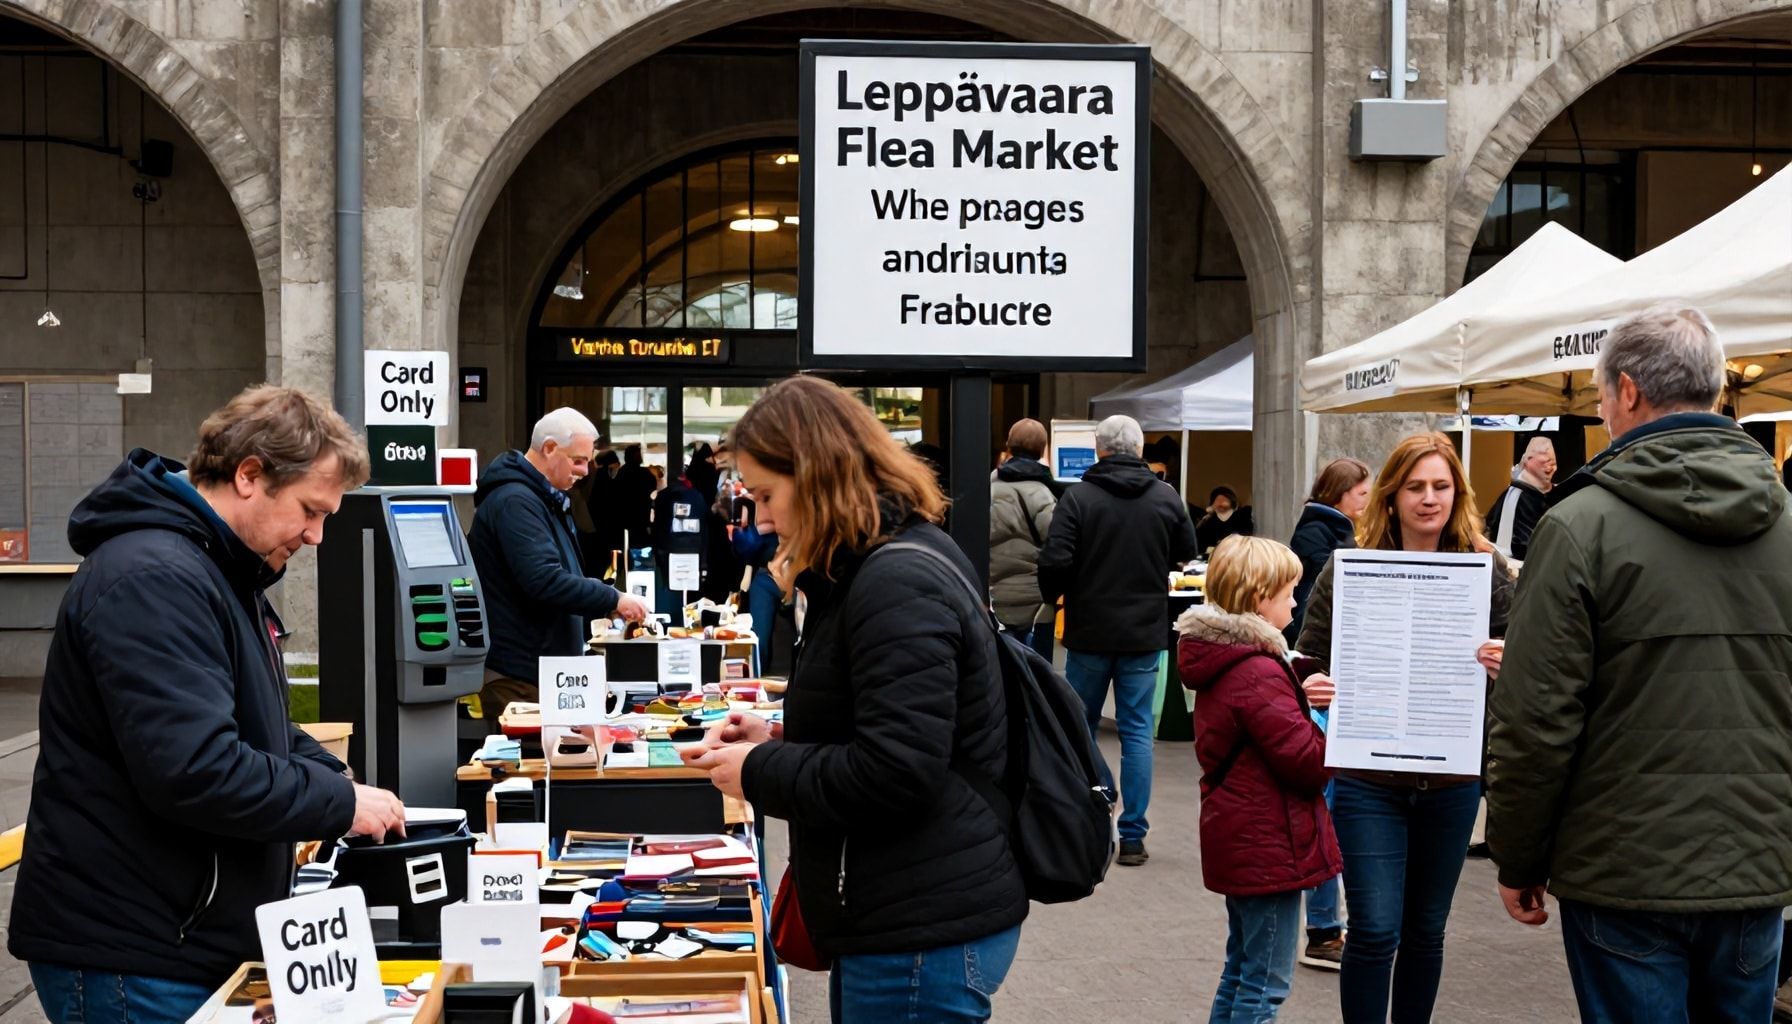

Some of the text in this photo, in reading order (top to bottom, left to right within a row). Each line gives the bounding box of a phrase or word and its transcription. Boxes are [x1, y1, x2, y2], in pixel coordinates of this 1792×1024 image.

[837, 69, 1114, 122] Leppävaara
[837, 126, 1119, 172] Flea Market
[870, 187, 949, 221] Whe
[900, 293, 1052, 327] Frabucre
[380, 360, 434, 385] Card
[380, 389, 434, 420] Only
[280, 906, 348, 952] Card
